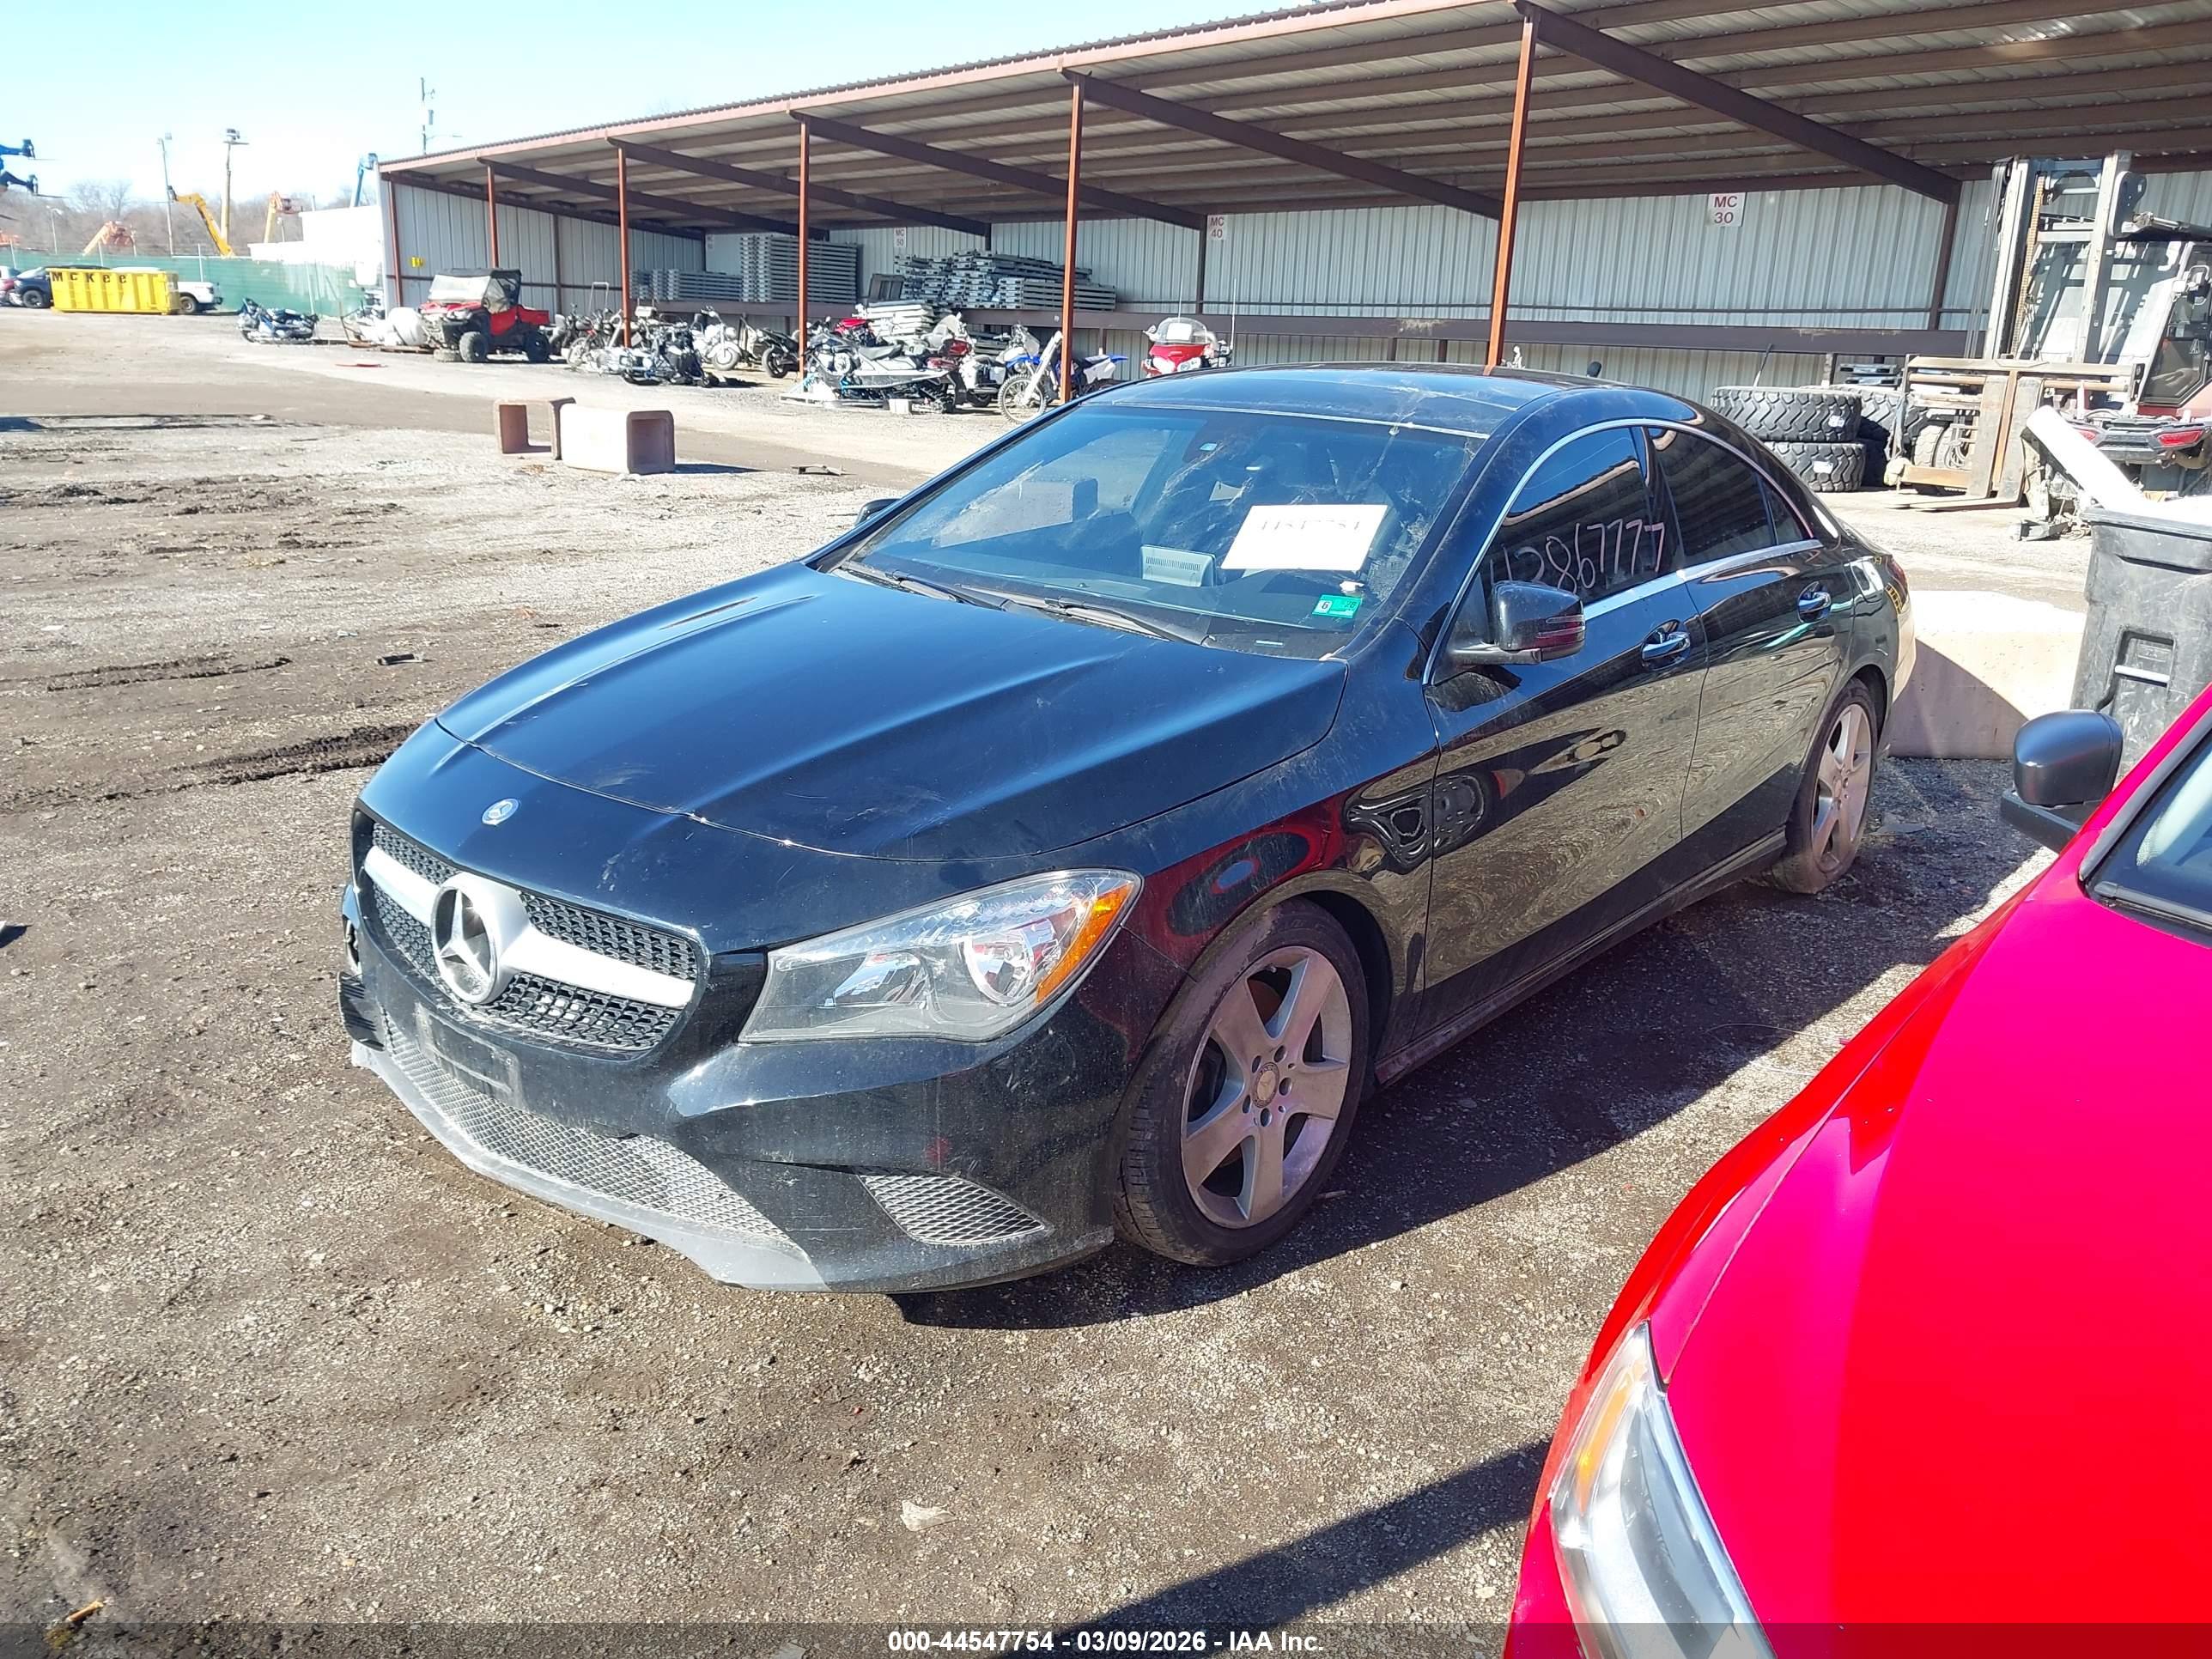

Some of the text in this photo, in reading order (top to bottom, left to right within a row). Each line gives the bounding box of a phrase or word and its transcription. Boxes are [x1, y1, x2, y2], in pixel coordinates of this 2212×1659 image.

[1714, 195, 1738, 208] MC
[1211, 216, 1224, 227] MC
[1713, 211, 1734, 224] 30
[1211, 228, 1223, 239] 40
[1322, 601, 1330, 610] 6
